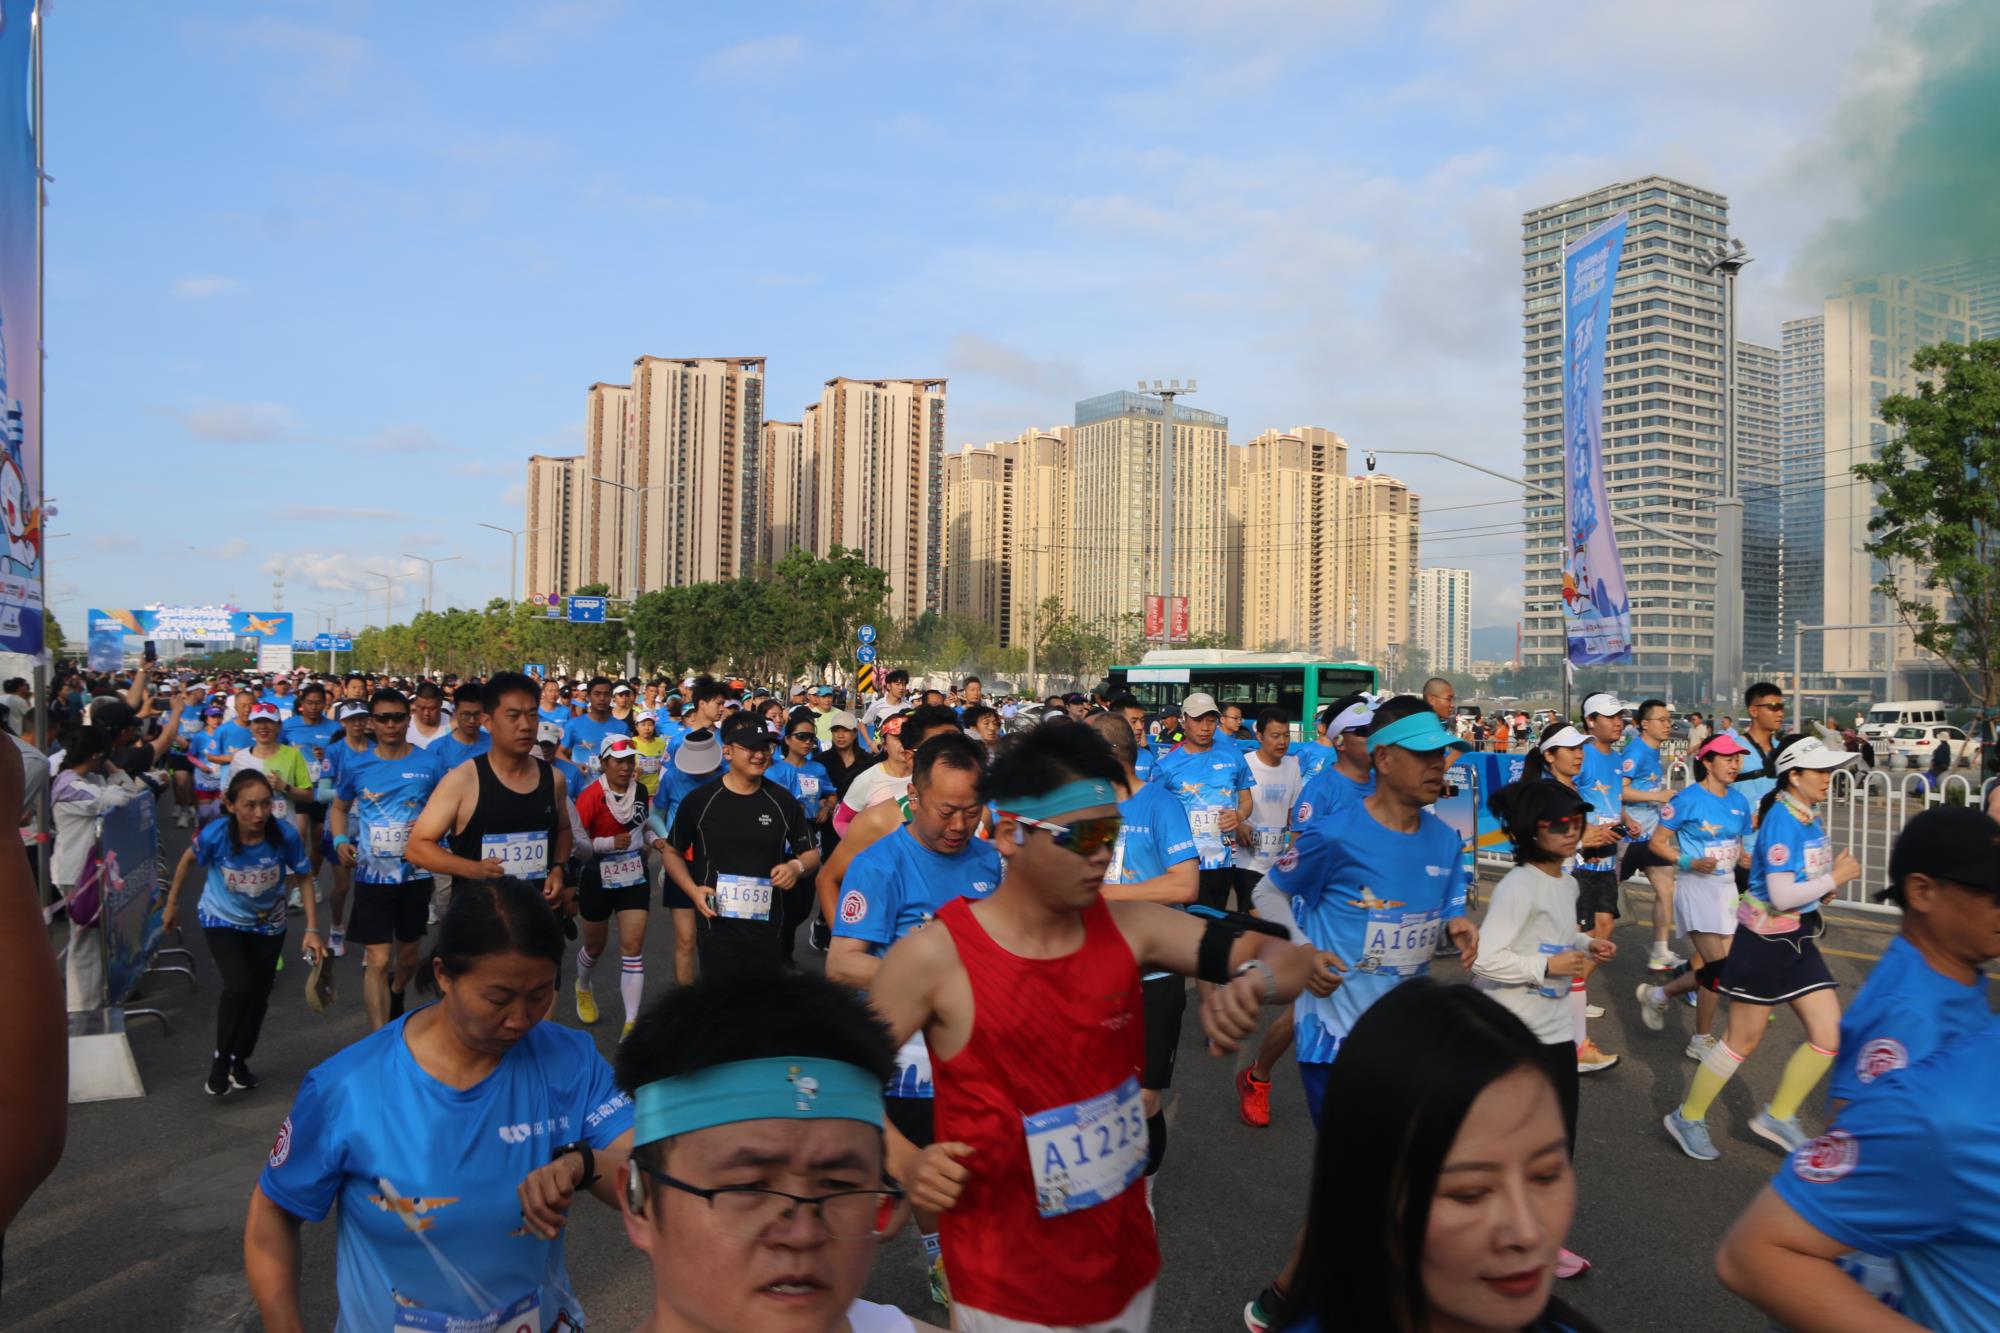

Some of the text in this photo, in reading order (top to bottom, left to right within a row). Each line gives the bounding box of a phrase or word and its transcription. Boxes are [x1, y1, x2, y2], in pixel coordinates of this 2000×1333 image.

[374, 831, 410, 842] A193
[488, 845, 544, 862] A1320
[603, 860, 642, 876] A2434
[228, 869, 278, 885] A2255
[719, 886, 769, 904] A1658
[1044, 1105, 1143, 1175] A1225
